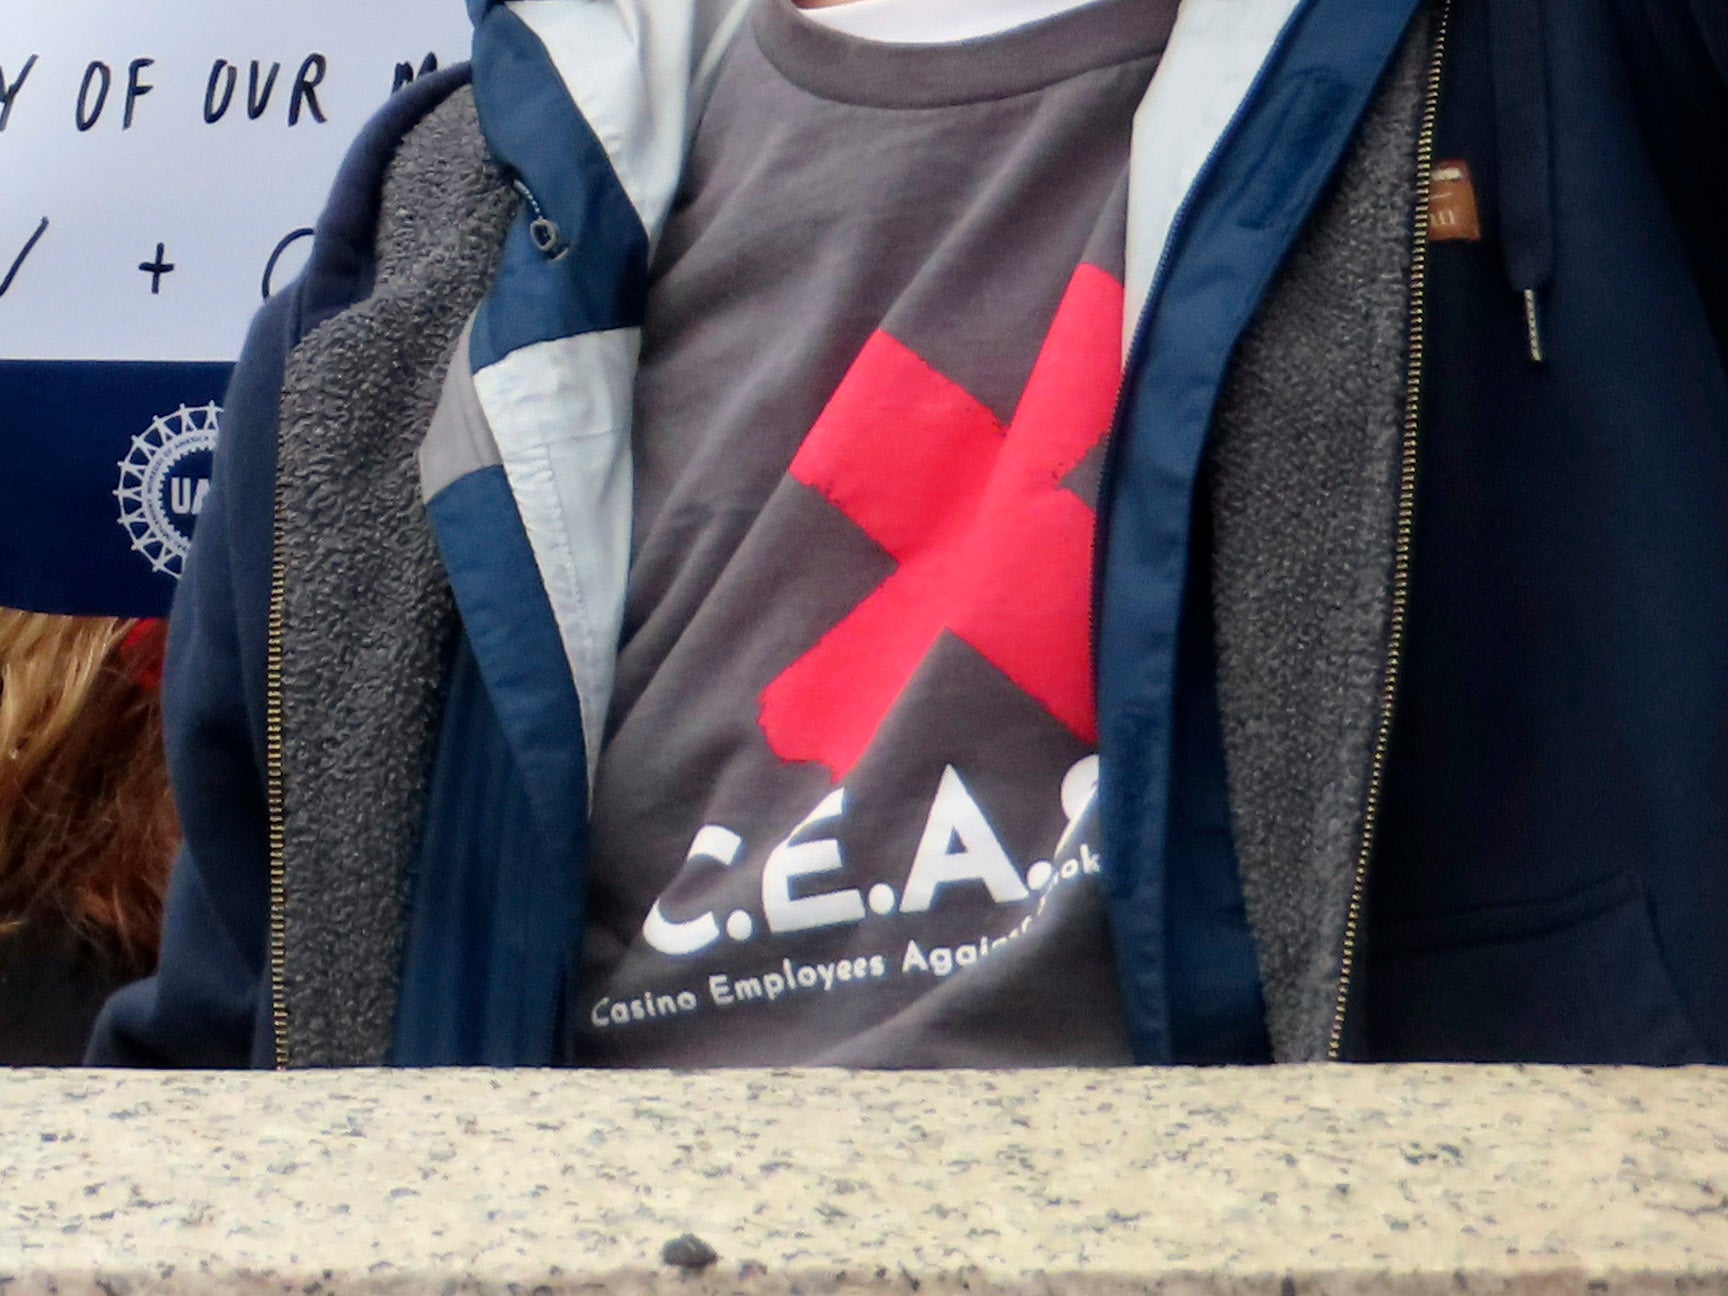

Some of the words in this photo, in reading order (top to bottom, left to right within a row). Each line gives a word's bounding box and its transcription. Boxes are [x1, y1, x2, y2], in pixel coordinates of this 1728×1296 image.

[75, 57, 155, 132] OF
[202, 52, 328, 128] OUR
[590, 990, 698, 1028] Casino
[708, 954, 886, 1006] Employees
